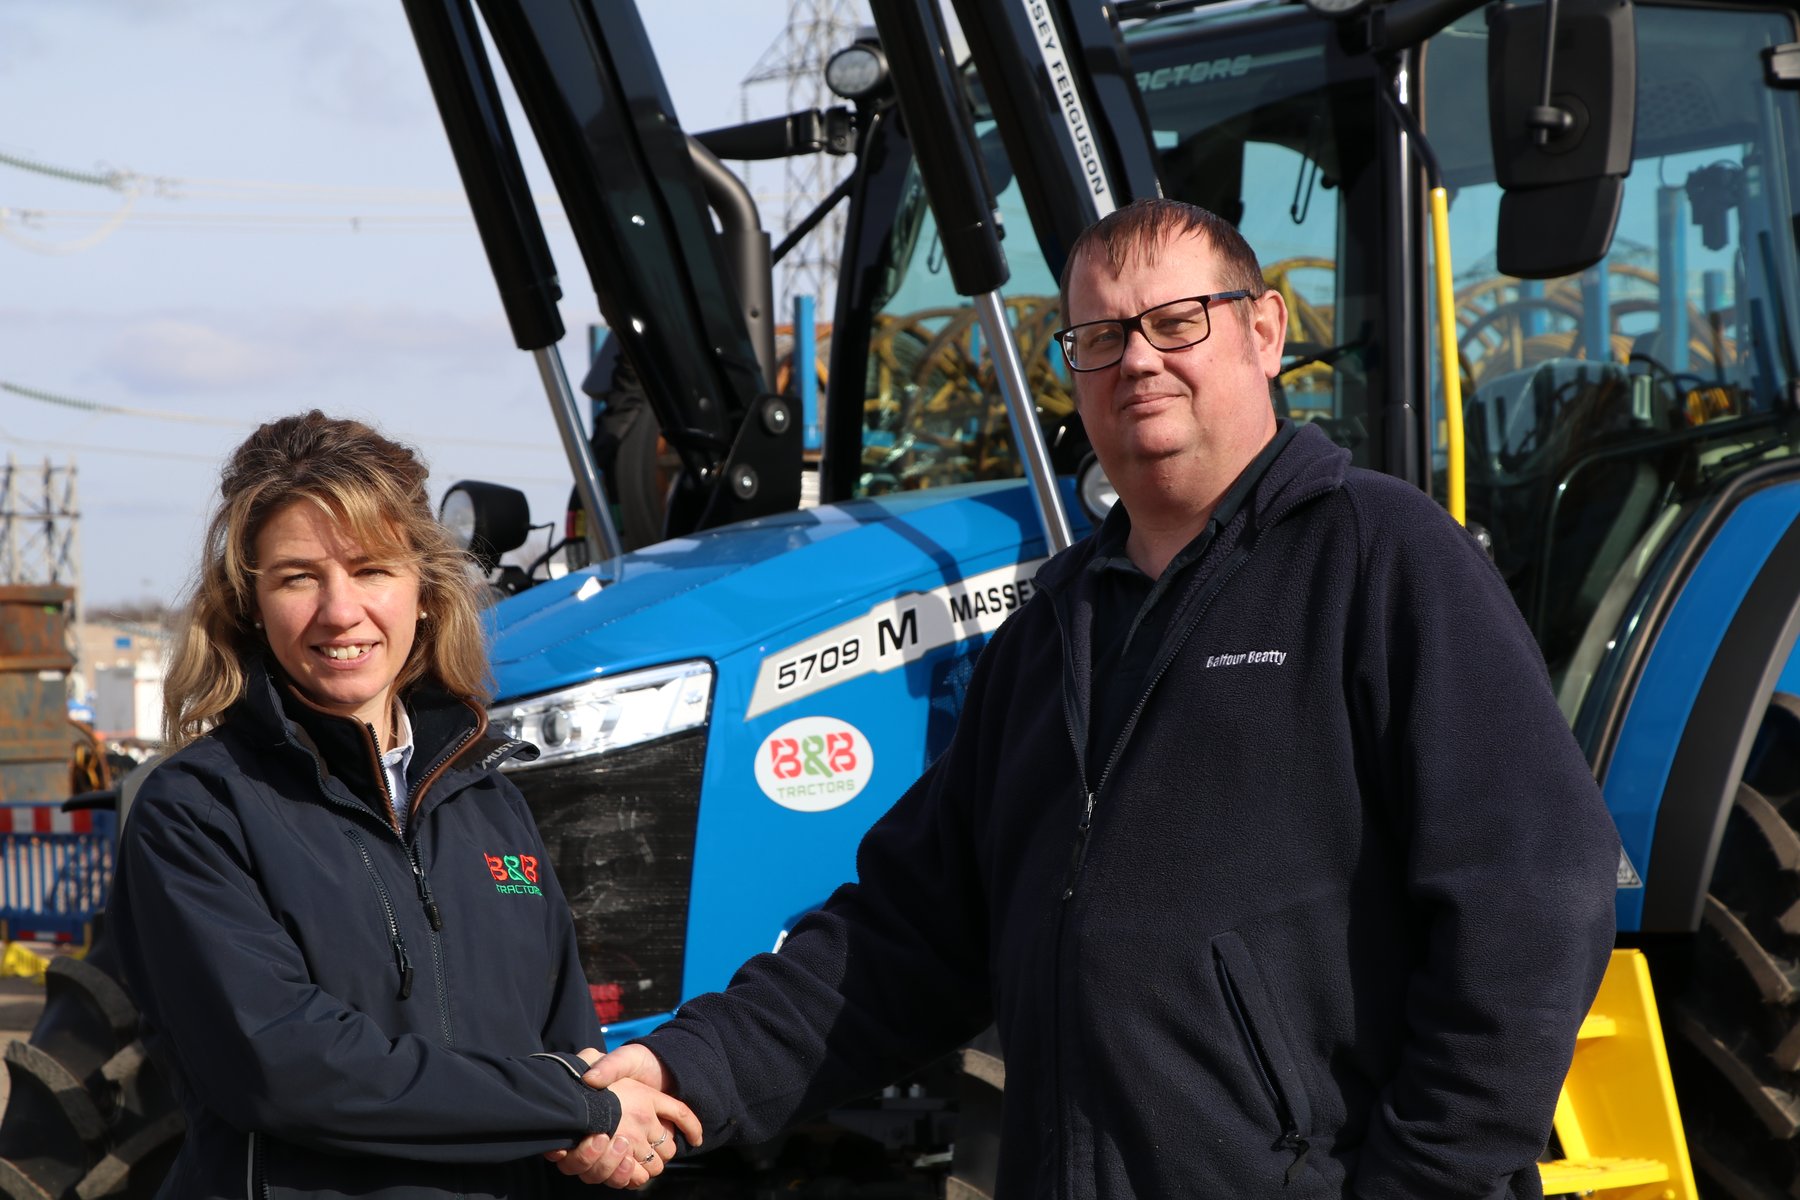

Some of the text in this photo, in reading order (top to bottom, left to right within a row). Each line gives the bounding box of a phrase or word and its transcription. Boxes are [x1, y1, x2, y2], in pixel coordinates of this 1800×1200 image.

[1028, 0, 1105, 195] SEY FERGUSON
[777, 638, 859, 690] 5709
[877, 608, 918, 656] M
[1206, 649, 1287, 668] Balfour Beatty
[770, 732, 857, 779] B&B
[776, 779, 855, 799] TRACTORS
[484, 852, 538, 883] B&B
